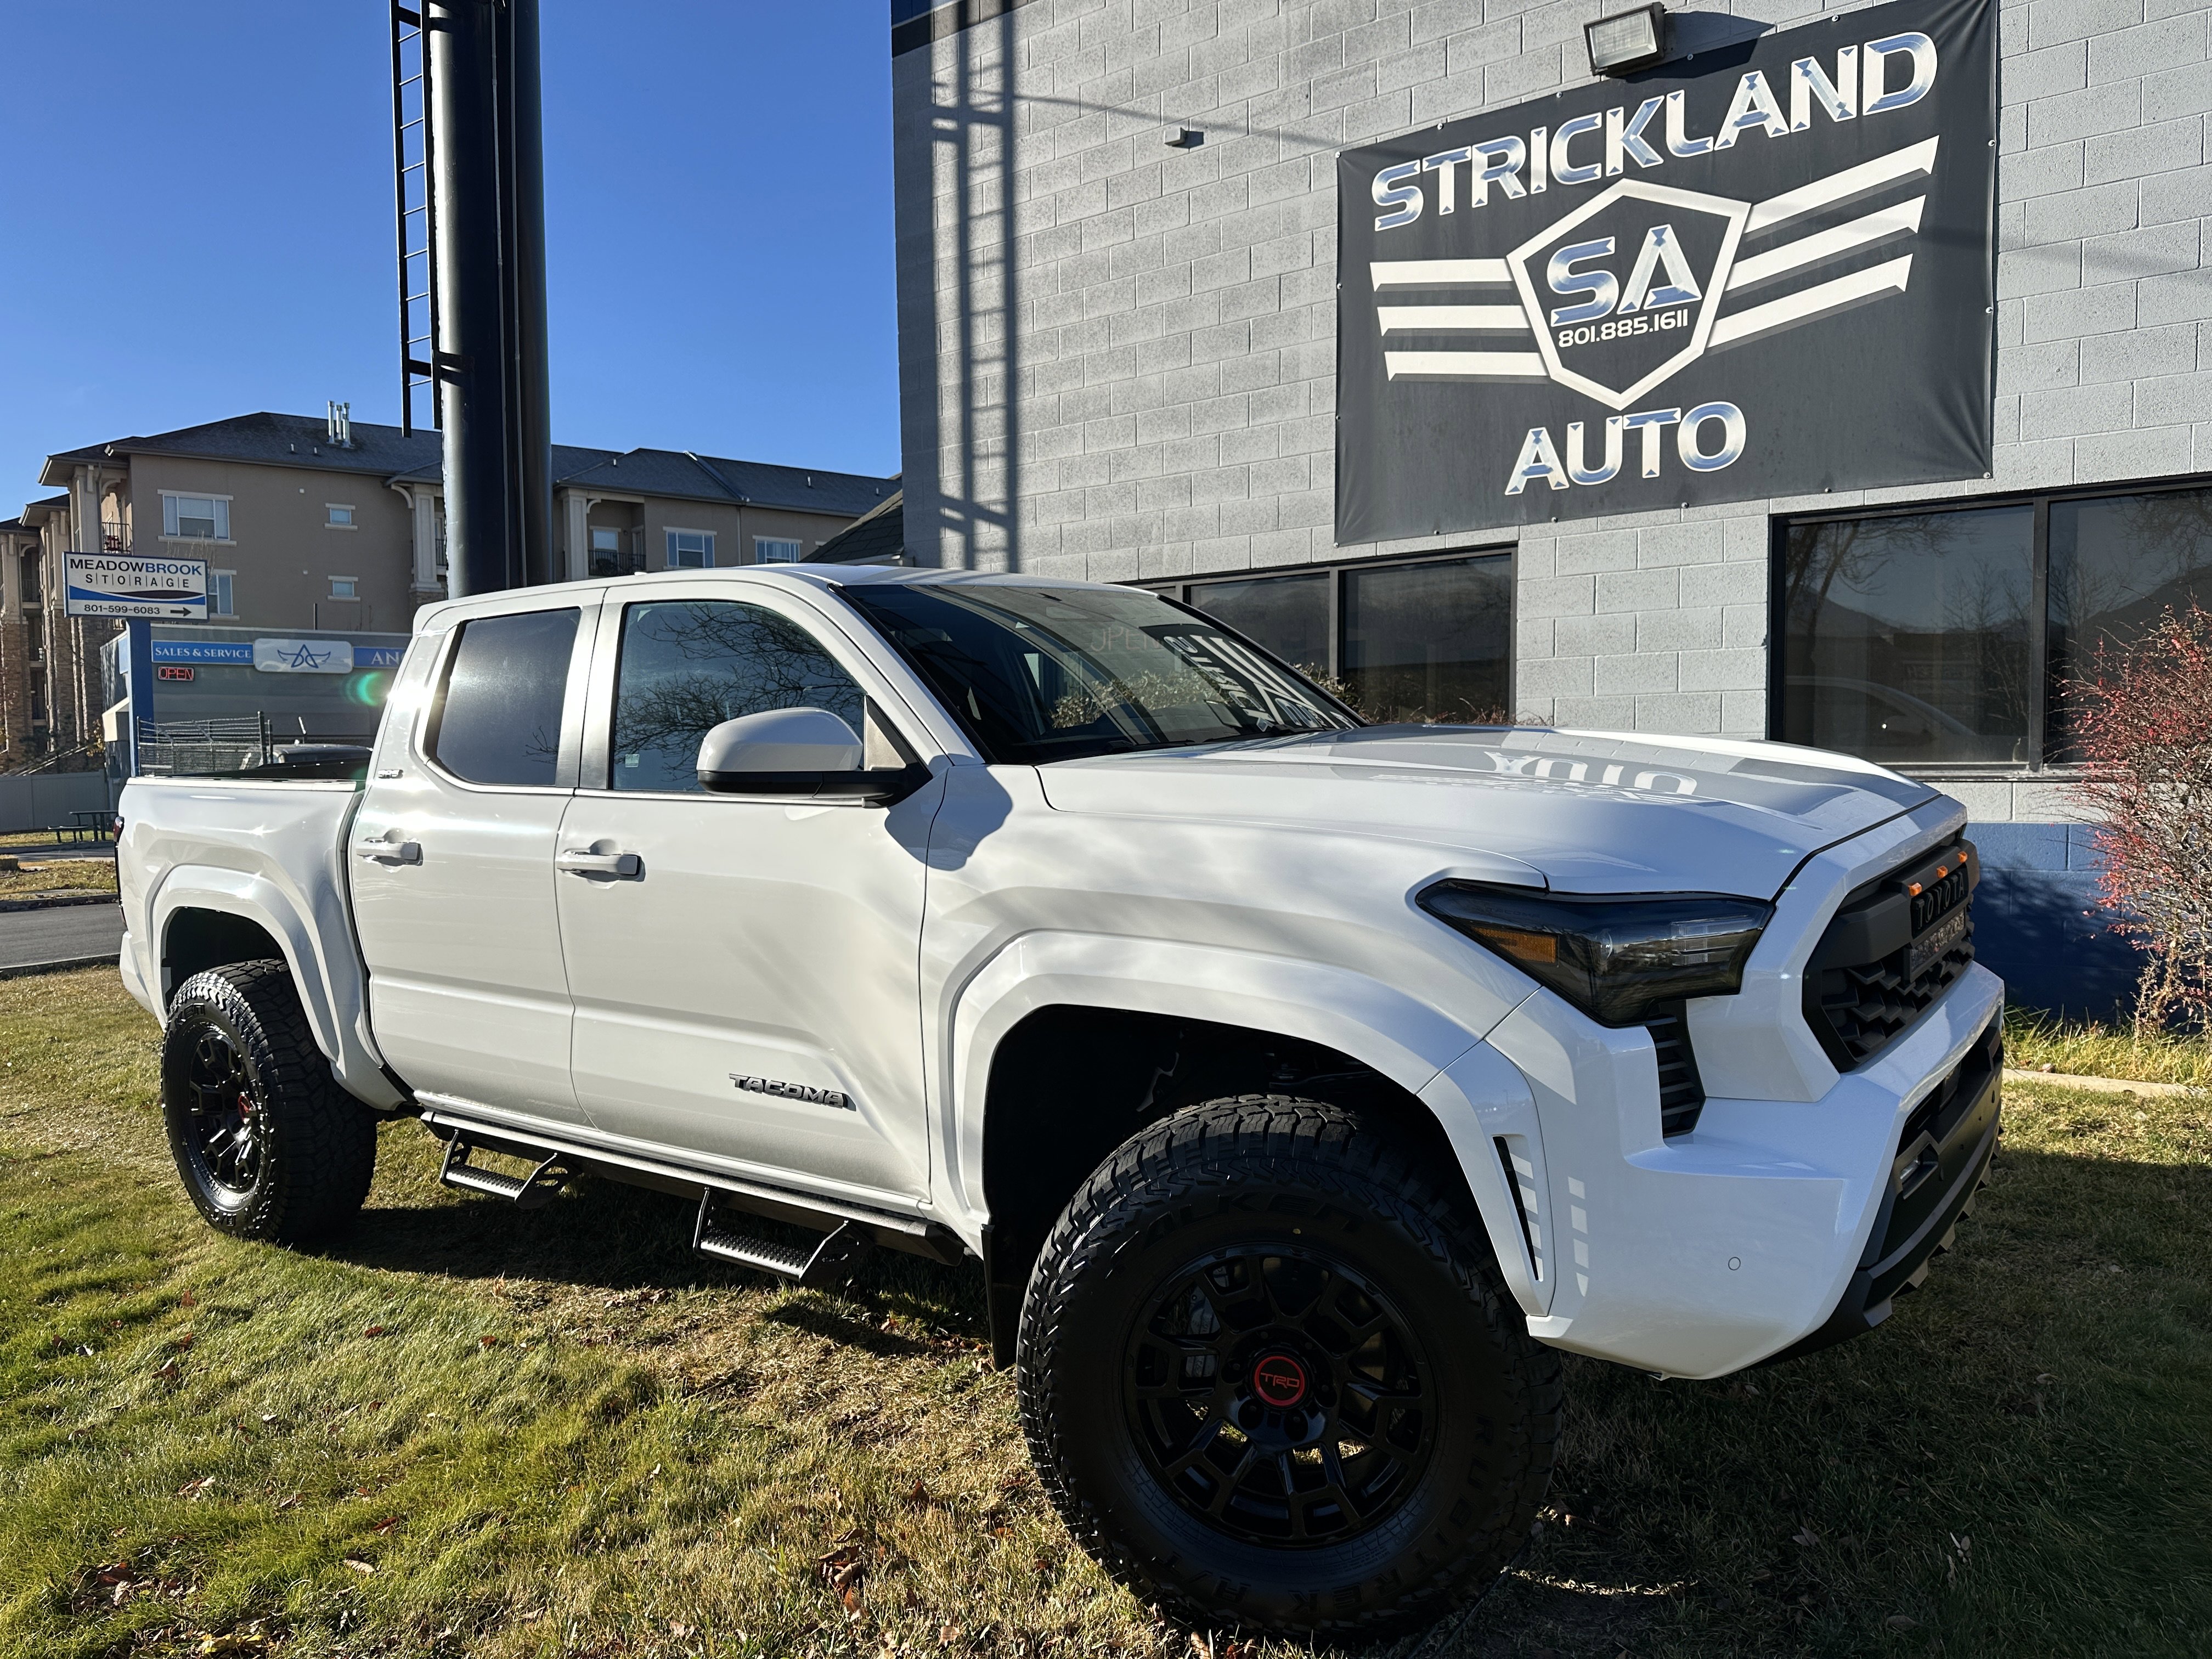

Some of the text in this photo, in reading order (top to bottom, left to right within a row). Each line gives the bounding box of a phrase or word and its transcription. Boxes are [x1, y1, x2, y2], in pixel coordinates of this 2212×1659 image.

[1370, 31, 1938, 232] STRICKLAND
[1547, 224, 1702, 328] SA
[1558, 308, 1689, 348] 801.885.1611
[1504, 401, 1747, 496] AUTO
[70, 558, 202, 575] MEADOWBROOK
[84, 604, 160, 614] 801-599-6083
[155, 647, 252, 658] SALES & SERVICE
[159, 667, 193, 680] OPEN
[1913, 871, 1965, 930] TOYOTA
[729, 1073, 850, 1109] TACOMA
[1260, 1372, 1300, 1390] TRD
